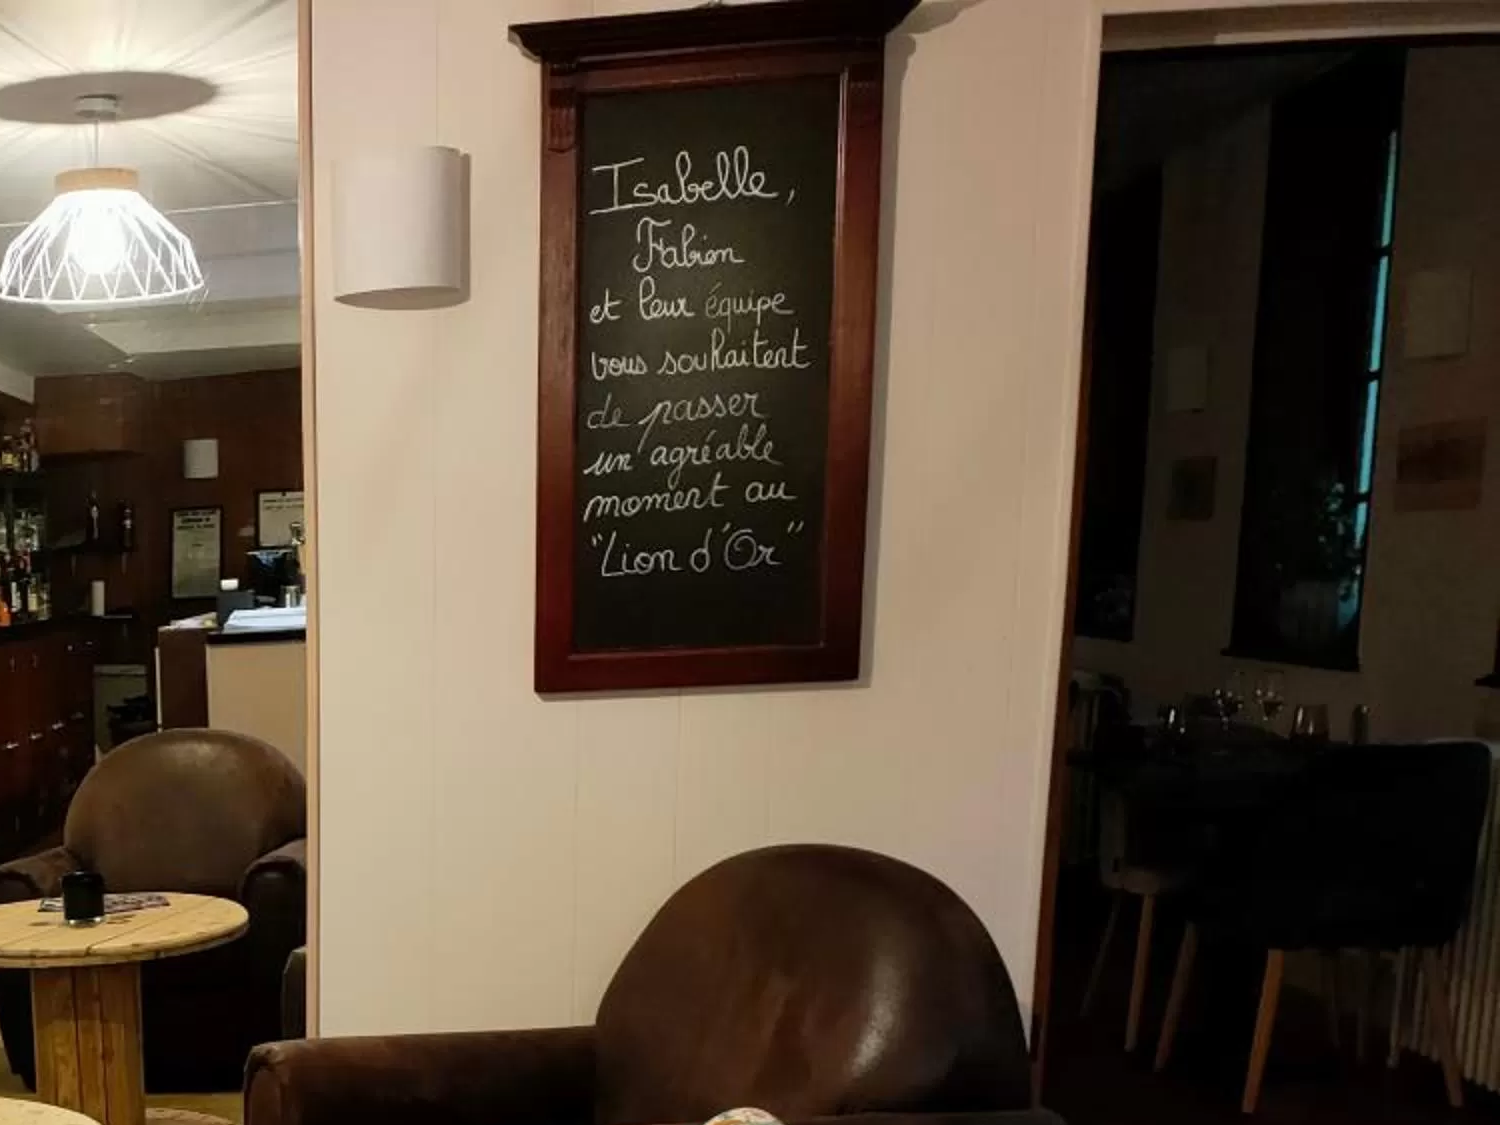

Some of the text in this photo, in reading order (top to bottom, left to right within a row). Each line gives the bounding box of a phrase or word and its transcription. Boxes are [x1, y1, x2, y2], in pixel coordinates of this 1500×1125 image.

[589, 146, 796, 214] Isabelle,
[590, 276, 794, 332] et leur équipe
[592, 328, 815, 380] vous souhaitent
[587, 392, 767, 453] de passer
[583, 423, 784, 490] un agréable
[584, 471, 798, 522] moment au
[592, 530, 682, 577] "Lion
